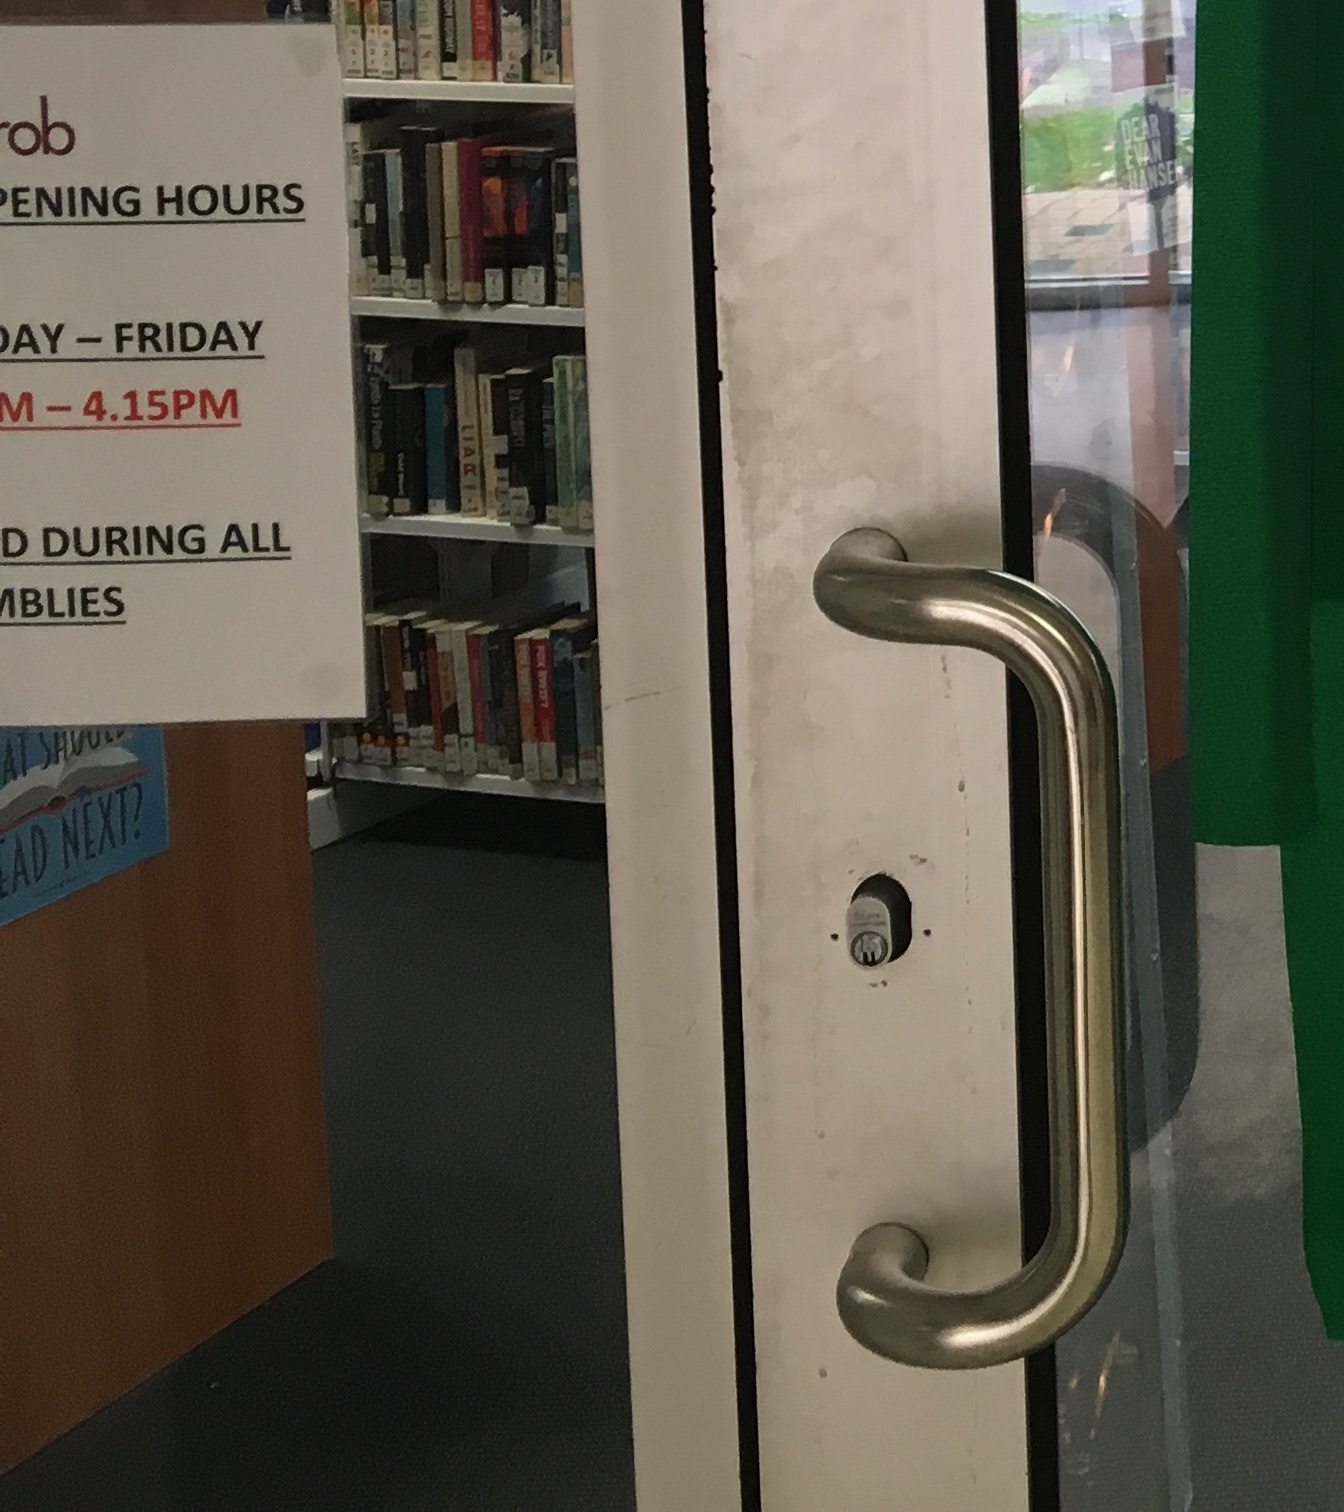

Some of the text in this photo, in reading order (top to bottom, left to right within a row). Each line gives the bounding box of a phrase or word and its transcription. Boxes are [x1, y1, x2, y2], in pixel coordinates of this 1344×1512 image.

[156, 182, 305, 217] HOURS
[115, 320, 264, 354] FRIDAY
[83, 388, 239, 423] 4.15PM
[42, 523, 207, 558] DURING
[220, 521, 291, 554] ALL
[61, 782, 144, 871] NEXT?
